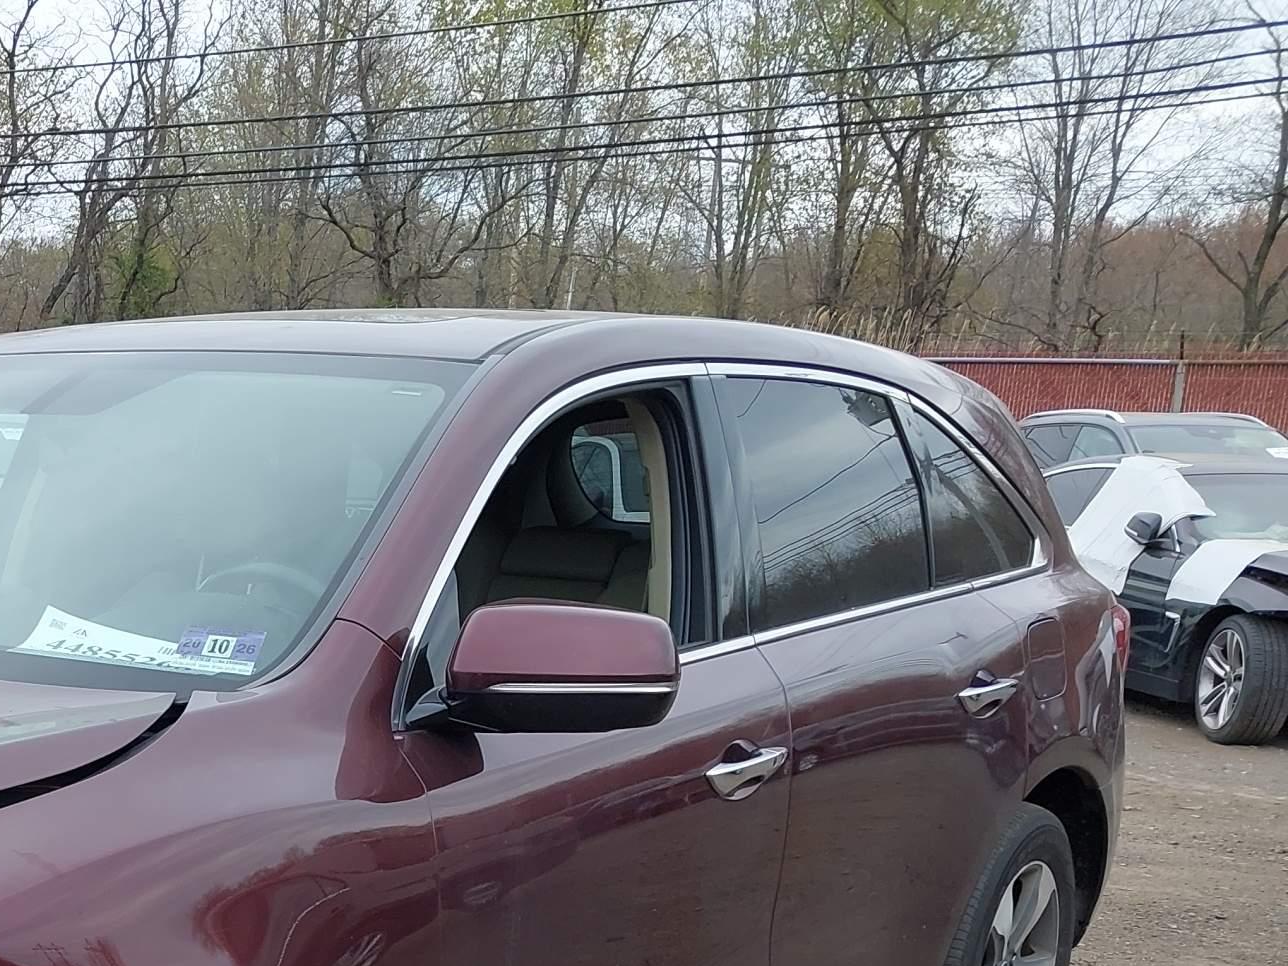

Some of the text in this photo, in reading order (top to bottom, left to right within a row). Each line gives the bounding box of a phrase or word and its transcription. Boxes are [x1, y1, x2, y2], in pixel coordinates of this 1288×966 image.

[182, 638, 257, 655] 20 10 26
